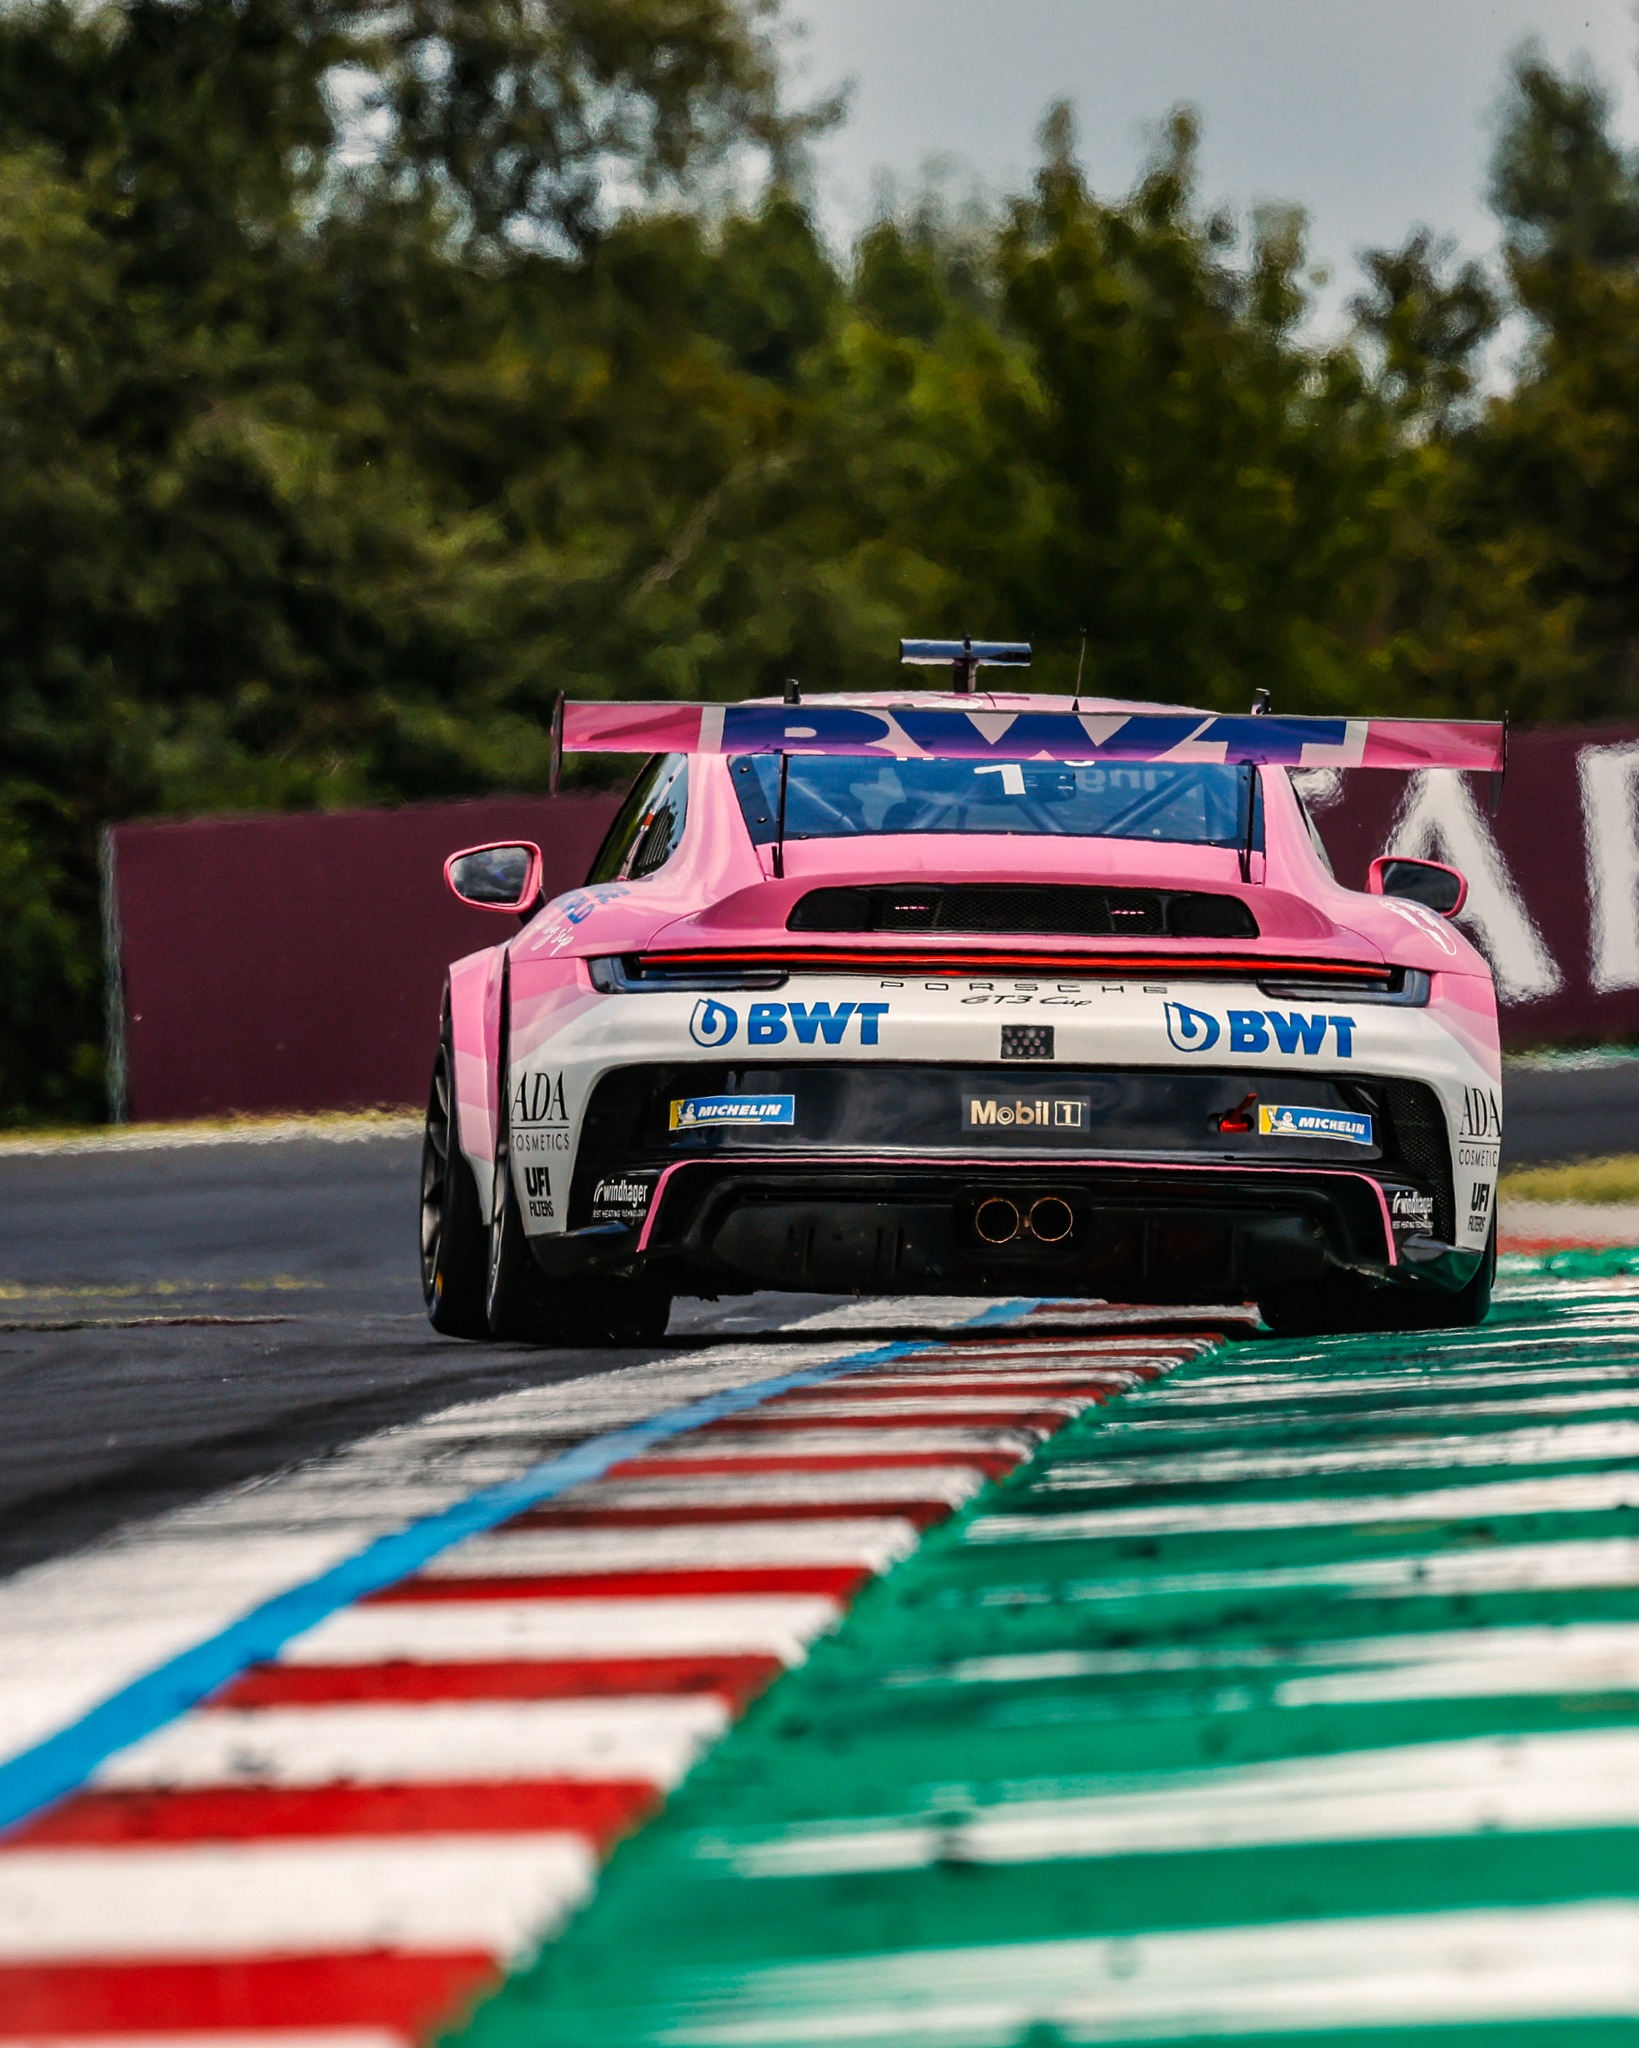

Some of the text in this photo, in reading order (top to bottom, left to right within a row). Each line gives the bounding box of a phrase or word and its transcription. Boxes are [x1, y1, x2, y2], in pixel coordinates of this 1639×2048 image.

[880, 980, 1168, 994] PORSCHE
[960, 995, 1093, 1007] GT3 Cup
[747, 1002, 890, 1045] BWT
[1226, 1010, 1357, 1058] BWT
[511, 1070, 570, 1122] ADA
[697, 1104, 782, 1118] MICHELIN
[970, 1099, 1050, 1126] Mobil
[1298, 1117, 1365, 1135] MICHELIN
[1459, 1085, 1502, 1138] ADA
[524, 1166, 551, 1198] UFI
[603, 1179, 648, 1209] windhager
[528, 1201, 555, 1218] FILTERS
[1471, 1182, 1491, 1213] UFI
